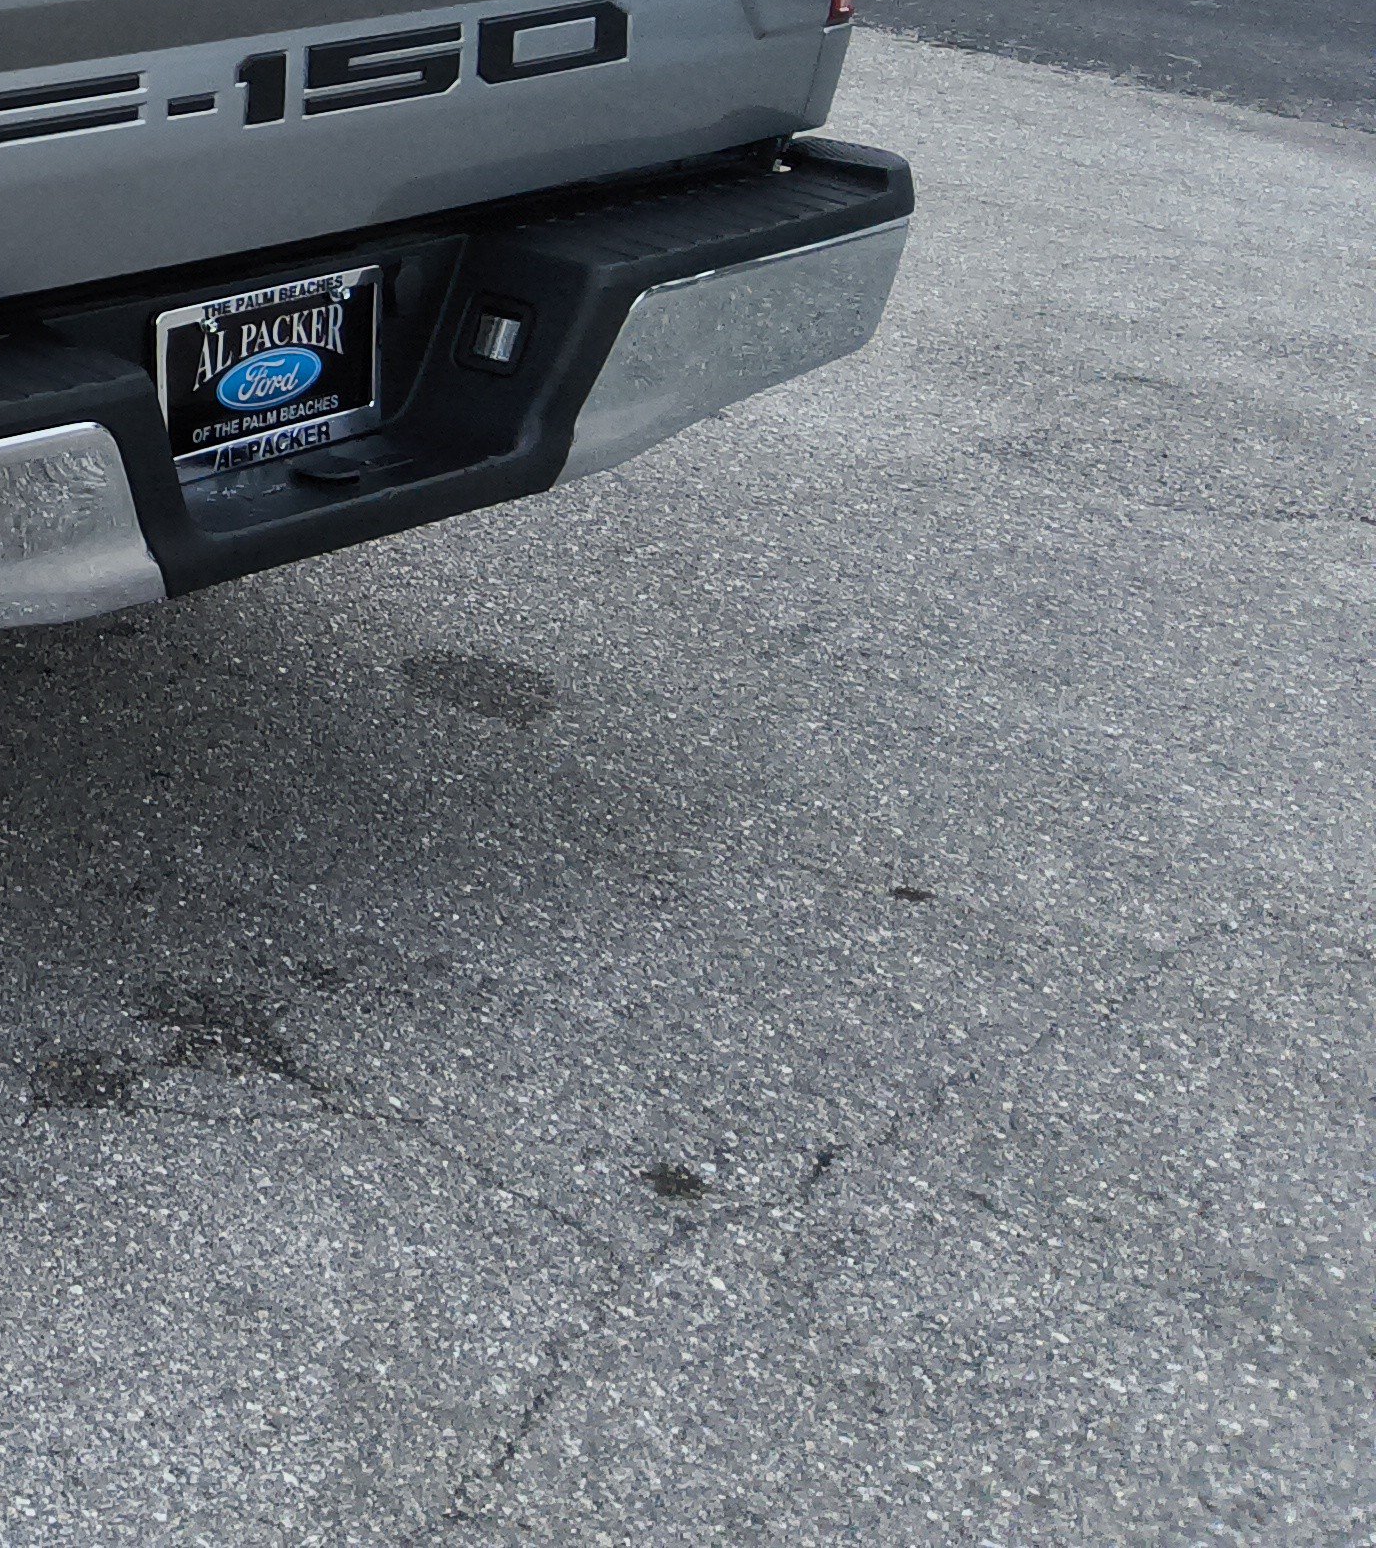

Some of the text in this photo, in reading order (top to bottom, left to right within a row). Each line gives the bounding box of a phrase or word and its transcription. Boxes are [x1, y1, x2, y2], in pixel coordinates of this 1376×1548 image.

[202, 275, 344, 319] THE PALM BEACHES
[192, 303, 345, 392] AL PACKER
[237, 358, 300, 401] Ford
[192, 394, 339, 444] OF THE PALM BEACHES
[213, 421, 331, 472] AL PACKER
